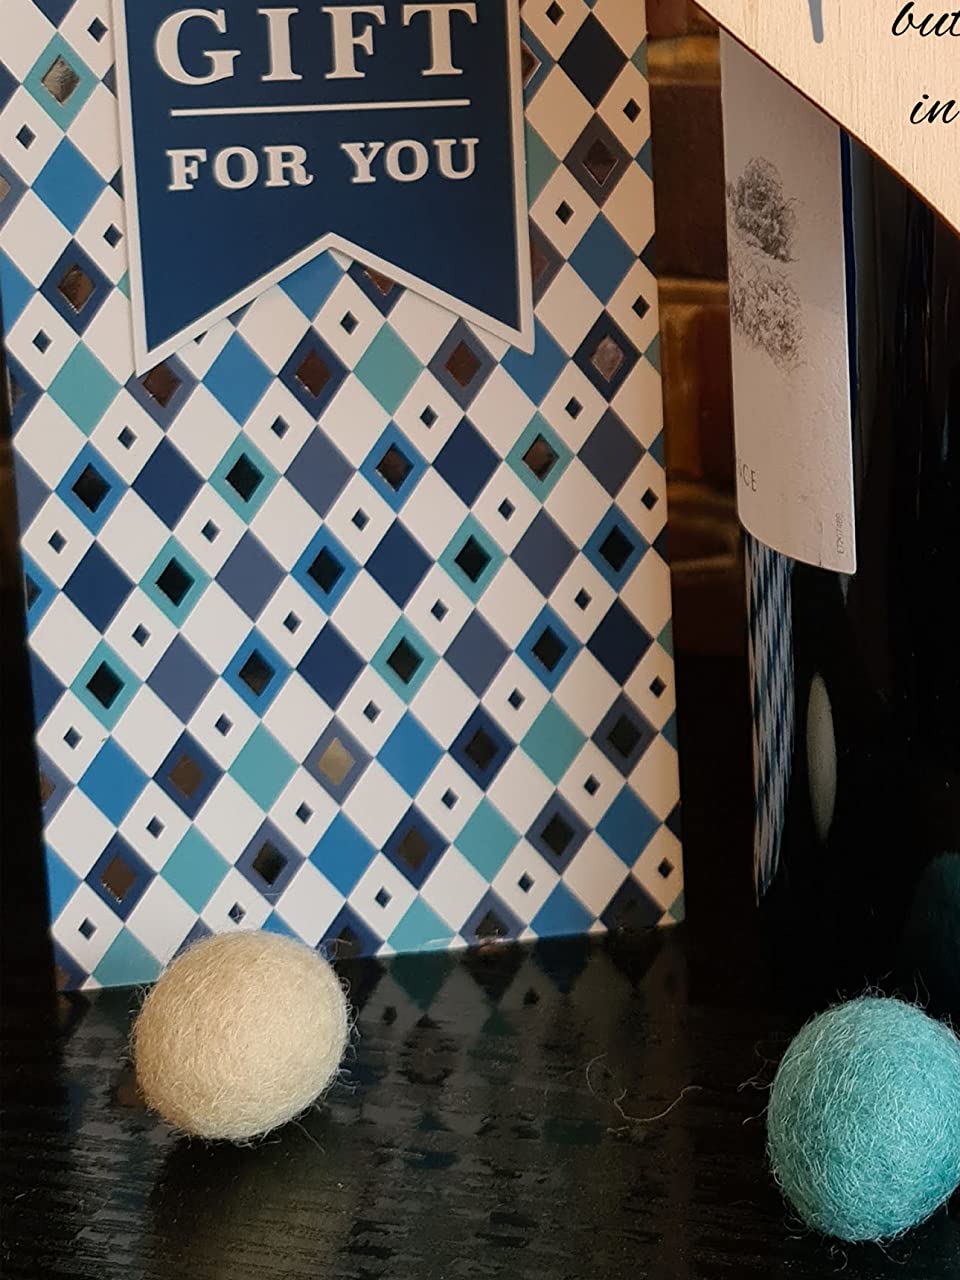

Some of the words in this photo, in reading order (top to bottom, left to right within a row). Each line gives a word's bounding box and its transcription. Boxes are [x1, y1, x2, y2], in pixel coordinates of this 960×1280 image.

[154, 2, 478, 86] GIFT
[909, 93, 960, 125] in
[166, 143, 314, 192] FOR
[340, 137, 480, 185] YOU
[740, 463, 757, 493] CE
